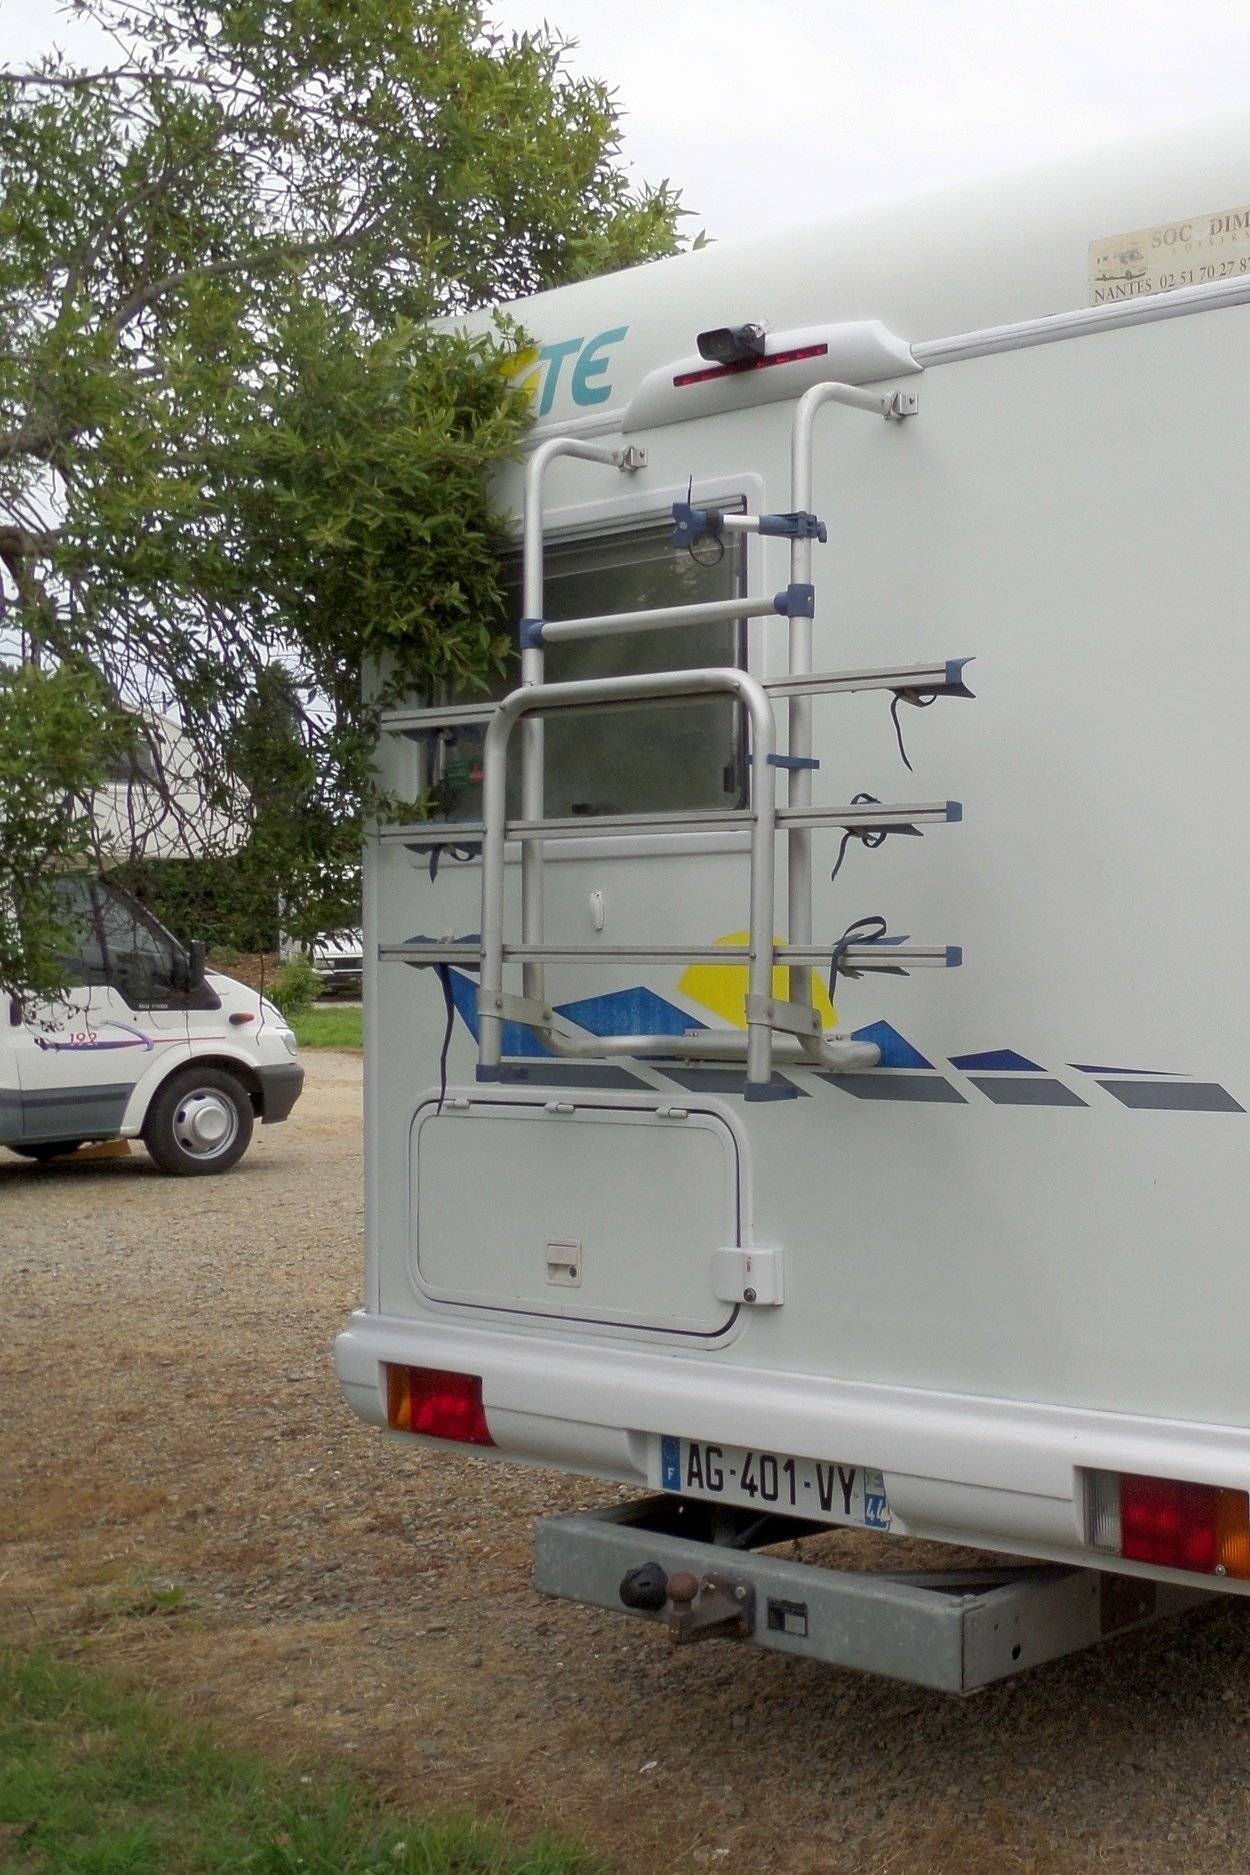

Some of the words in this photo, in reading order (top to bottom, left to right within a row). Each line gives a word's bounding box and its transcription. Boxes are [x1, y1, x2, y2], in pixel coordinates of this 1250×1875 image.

[1094, 278, 1152, 303] NANTES
[1159, 274, 1175, 289] 02
[1179, 270, 1194, 285] 51
[1199, 264, 1216, 281] 70
[1219, 260, 1235, 277] 27
[500, 325, 630, 418] TE
[667, 1467, 675, 1481] F
[686, 1442, 857, 1515] AG-401-VY
